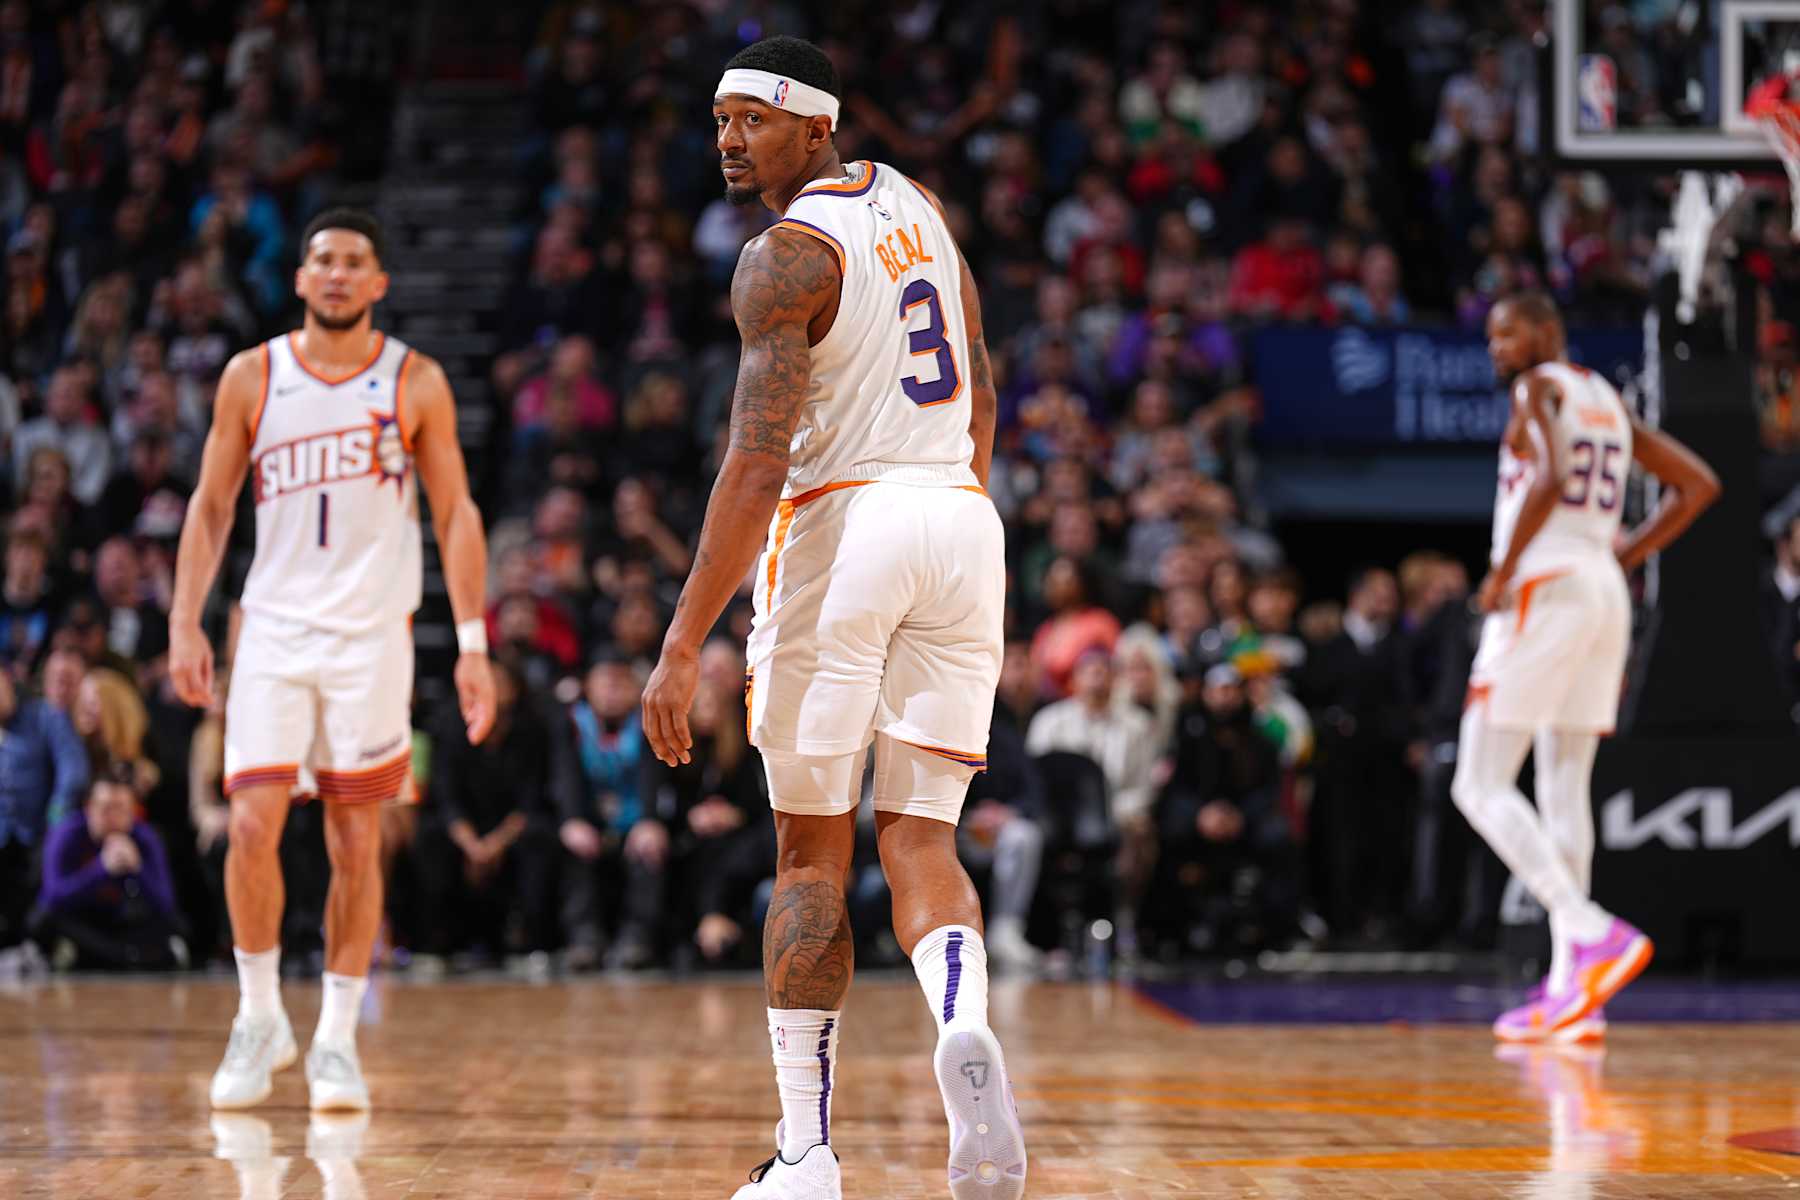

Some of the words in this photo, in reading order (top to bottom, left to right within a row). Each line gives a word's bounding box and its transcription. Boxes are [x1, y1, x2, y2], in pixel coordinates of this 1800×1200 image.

[875, 223, 933, 284] BEAL
[899, 279, 962, 408] 3
[1396, 385, 1508, 439] Heal
[260, 428, 373, 499] SUNS
[1561, 440, 1621, 511] 35
[319, 493, 329, 548] 1
